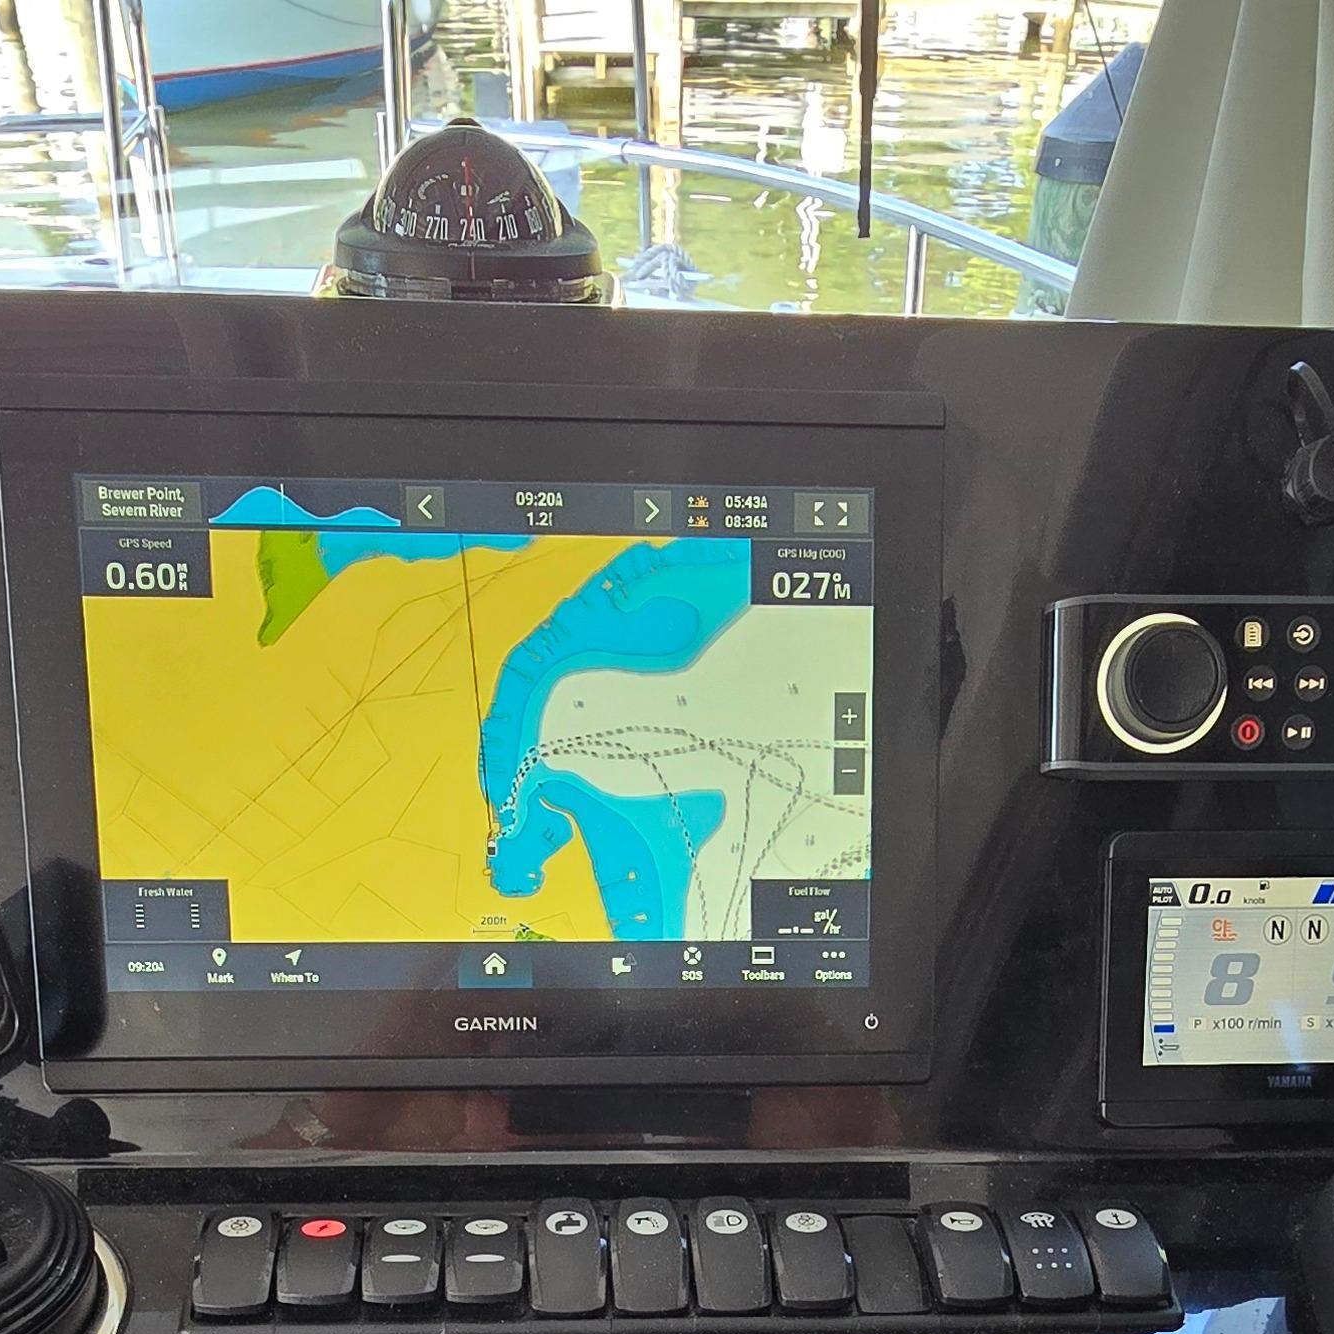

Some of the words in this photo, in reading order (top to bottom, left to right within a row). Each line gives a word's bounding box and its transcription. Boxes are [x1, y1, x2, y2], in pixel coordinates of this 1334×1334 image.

[425, 215, 449, 241] 270
[460, 218, 487, 241] 240
[496, 214, 518, 240] 210
[98, 486, 145, 501] Brewer
[147, 487, 185, 502] Point,
[101, 503, 147, 518] Severn
[149, 504, 183, 518] River
[119, 538, 140, 549] GPS
[142, 538, 172, 550] Speed
[777, 548, 797, 559] GPS
[819, 549, 846, 560] (COG)
[138, 886, 165, 897] Fresh
[166, 887, 194, 897] Water
[788, 886, 807, 896] Fuel
[809, 886, 831, 896] Flow
[1152, 886, 1173, 894] AUTO
[1188, 883, 1232, 905] 0.0
[1152, 895, 1173, 904] PILOT
[1243, 896, 1266, 905] knots
[480, 915, 507, 926] 200ft
[1271, 920, 1286, 940] N
[1308, 919, 1323, 940] N
[207, 972, 234, 984] Mark
[271, 972, 303, 984] Where
[304, 972, 320, 984] To
[681, 969, 703, 982] SOS
[742, 969, 785, 982] Toolbars
[815, 968, 852, 984] Options
[1204, 952, 1261, 1006] 8
[454, 1016, 538, 1032] GARMIN
[1213, 1016, 1244, 1030] x100
[1247, 1016, 1282, 1030] r/min
[1267, 1075, 1313, 1089] YAMAHA
